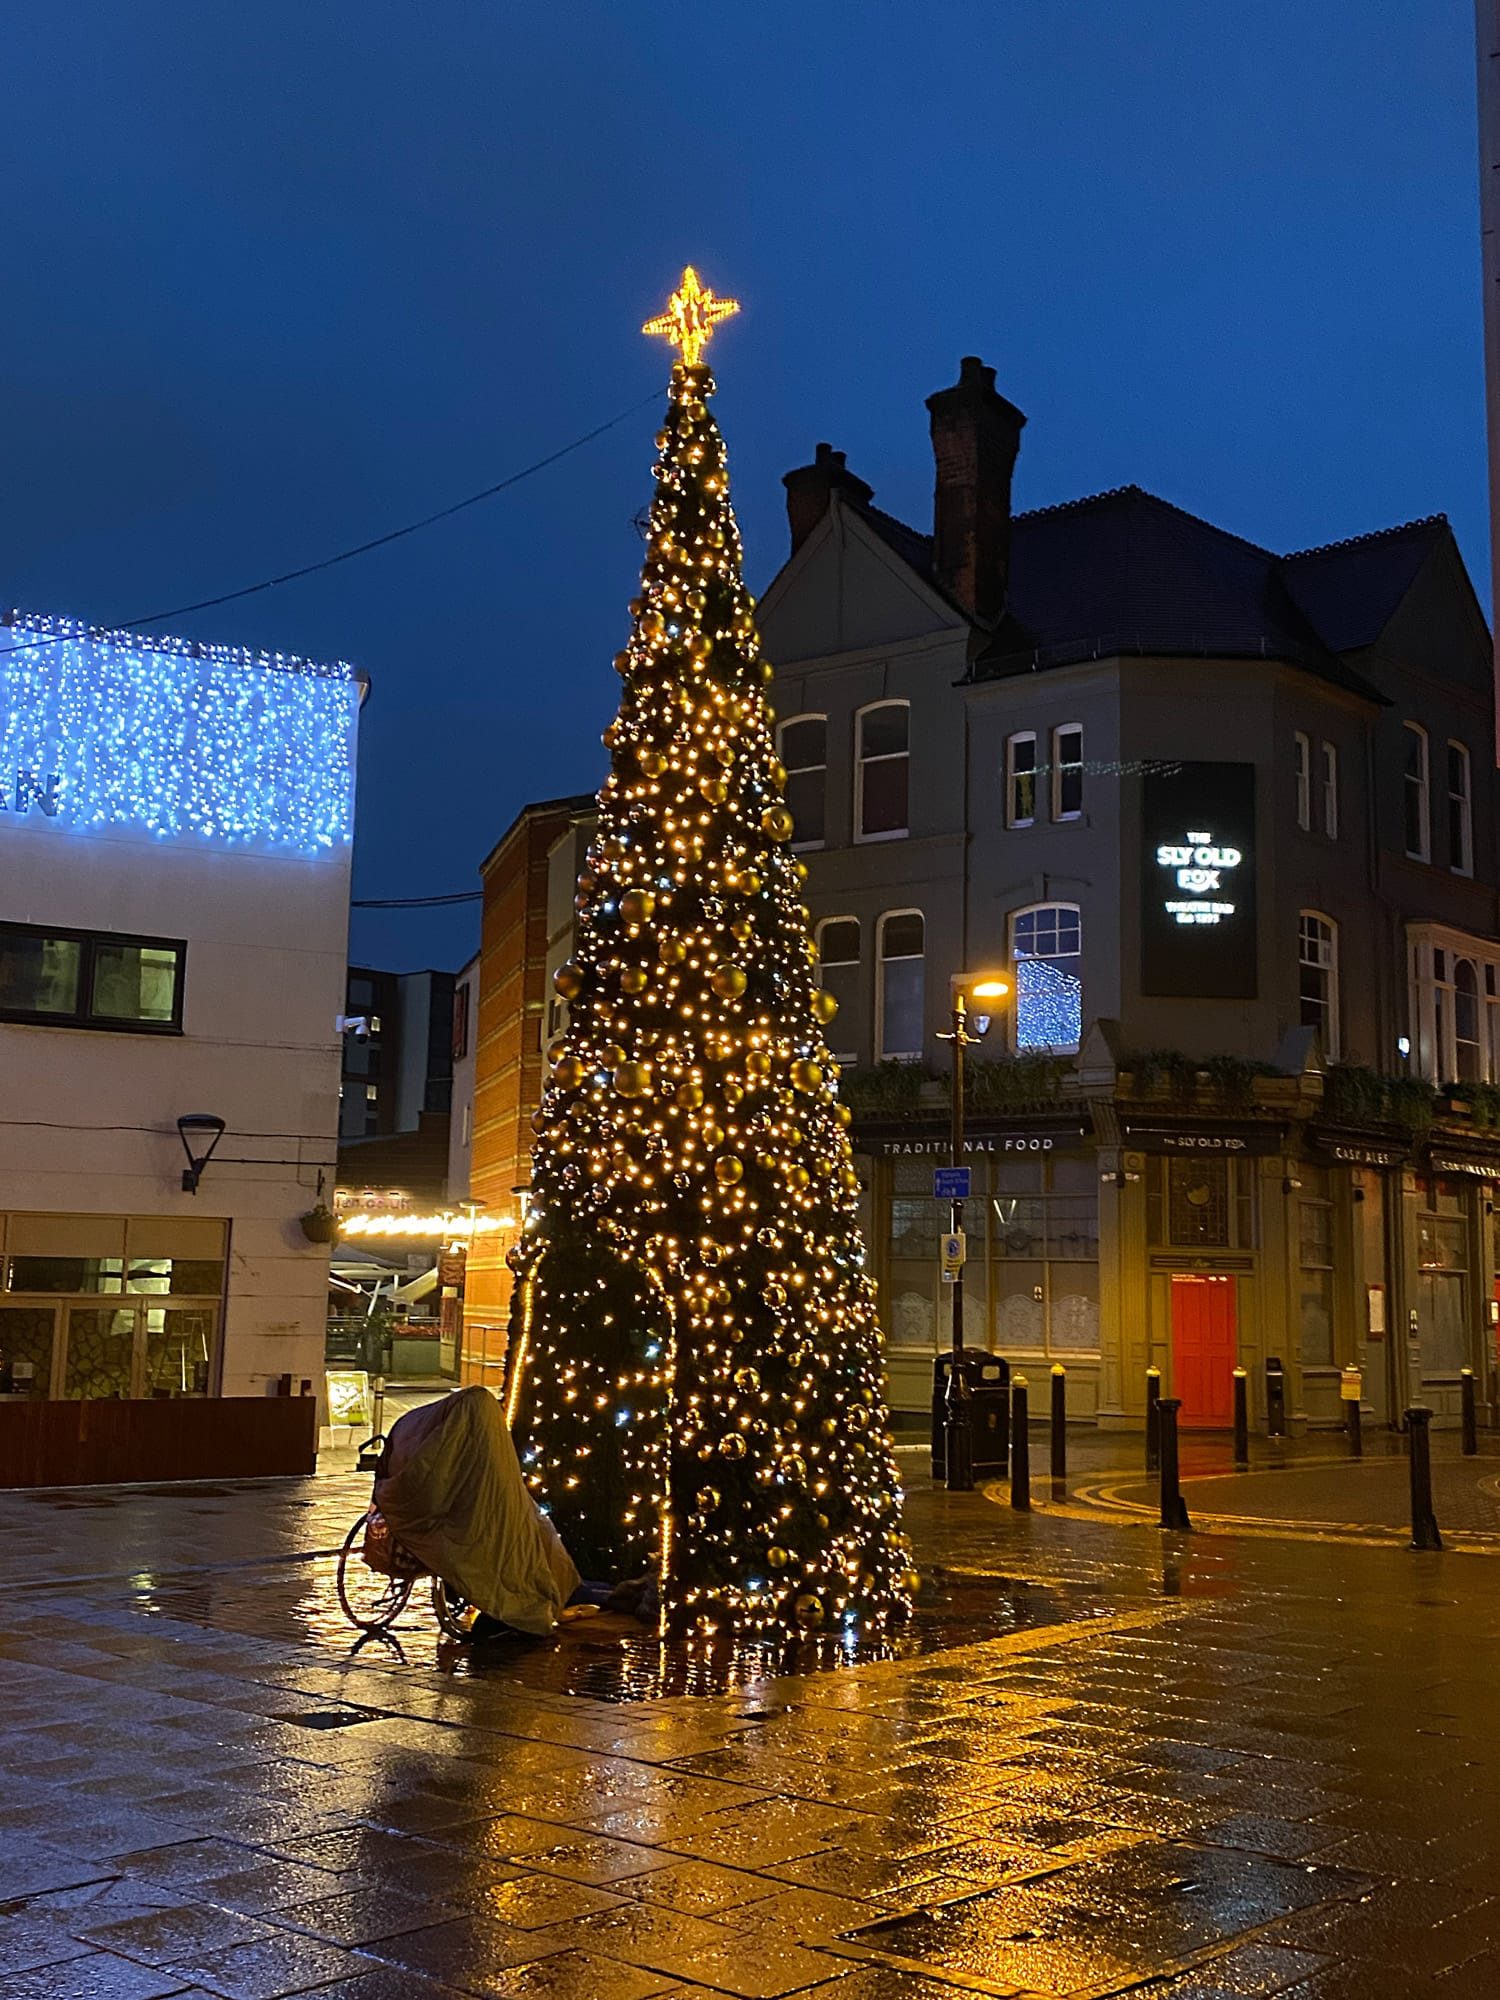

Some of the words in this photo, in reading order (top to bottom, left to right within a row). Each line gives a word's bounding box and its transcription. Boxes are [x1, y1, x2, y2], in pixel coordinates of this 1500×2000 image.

[1186, 832, 1211, 844] THE
[1157, 846, 1194, 865] SLY
[1194, 846, 1241, 867] OLD
[1177, 869, 1220, 892] FOX
[1005, 1139, 1053, 1151] FOOD
[1178, 1137, 1196, 1147] SLY
[1198, 1138, 1222, 1148] OLD
[1225, 1139, 1247, 1149] FOX
[1336, 1147, 1360, 1160] CASK
[1366, 1151, 1389, 1164] ALES
